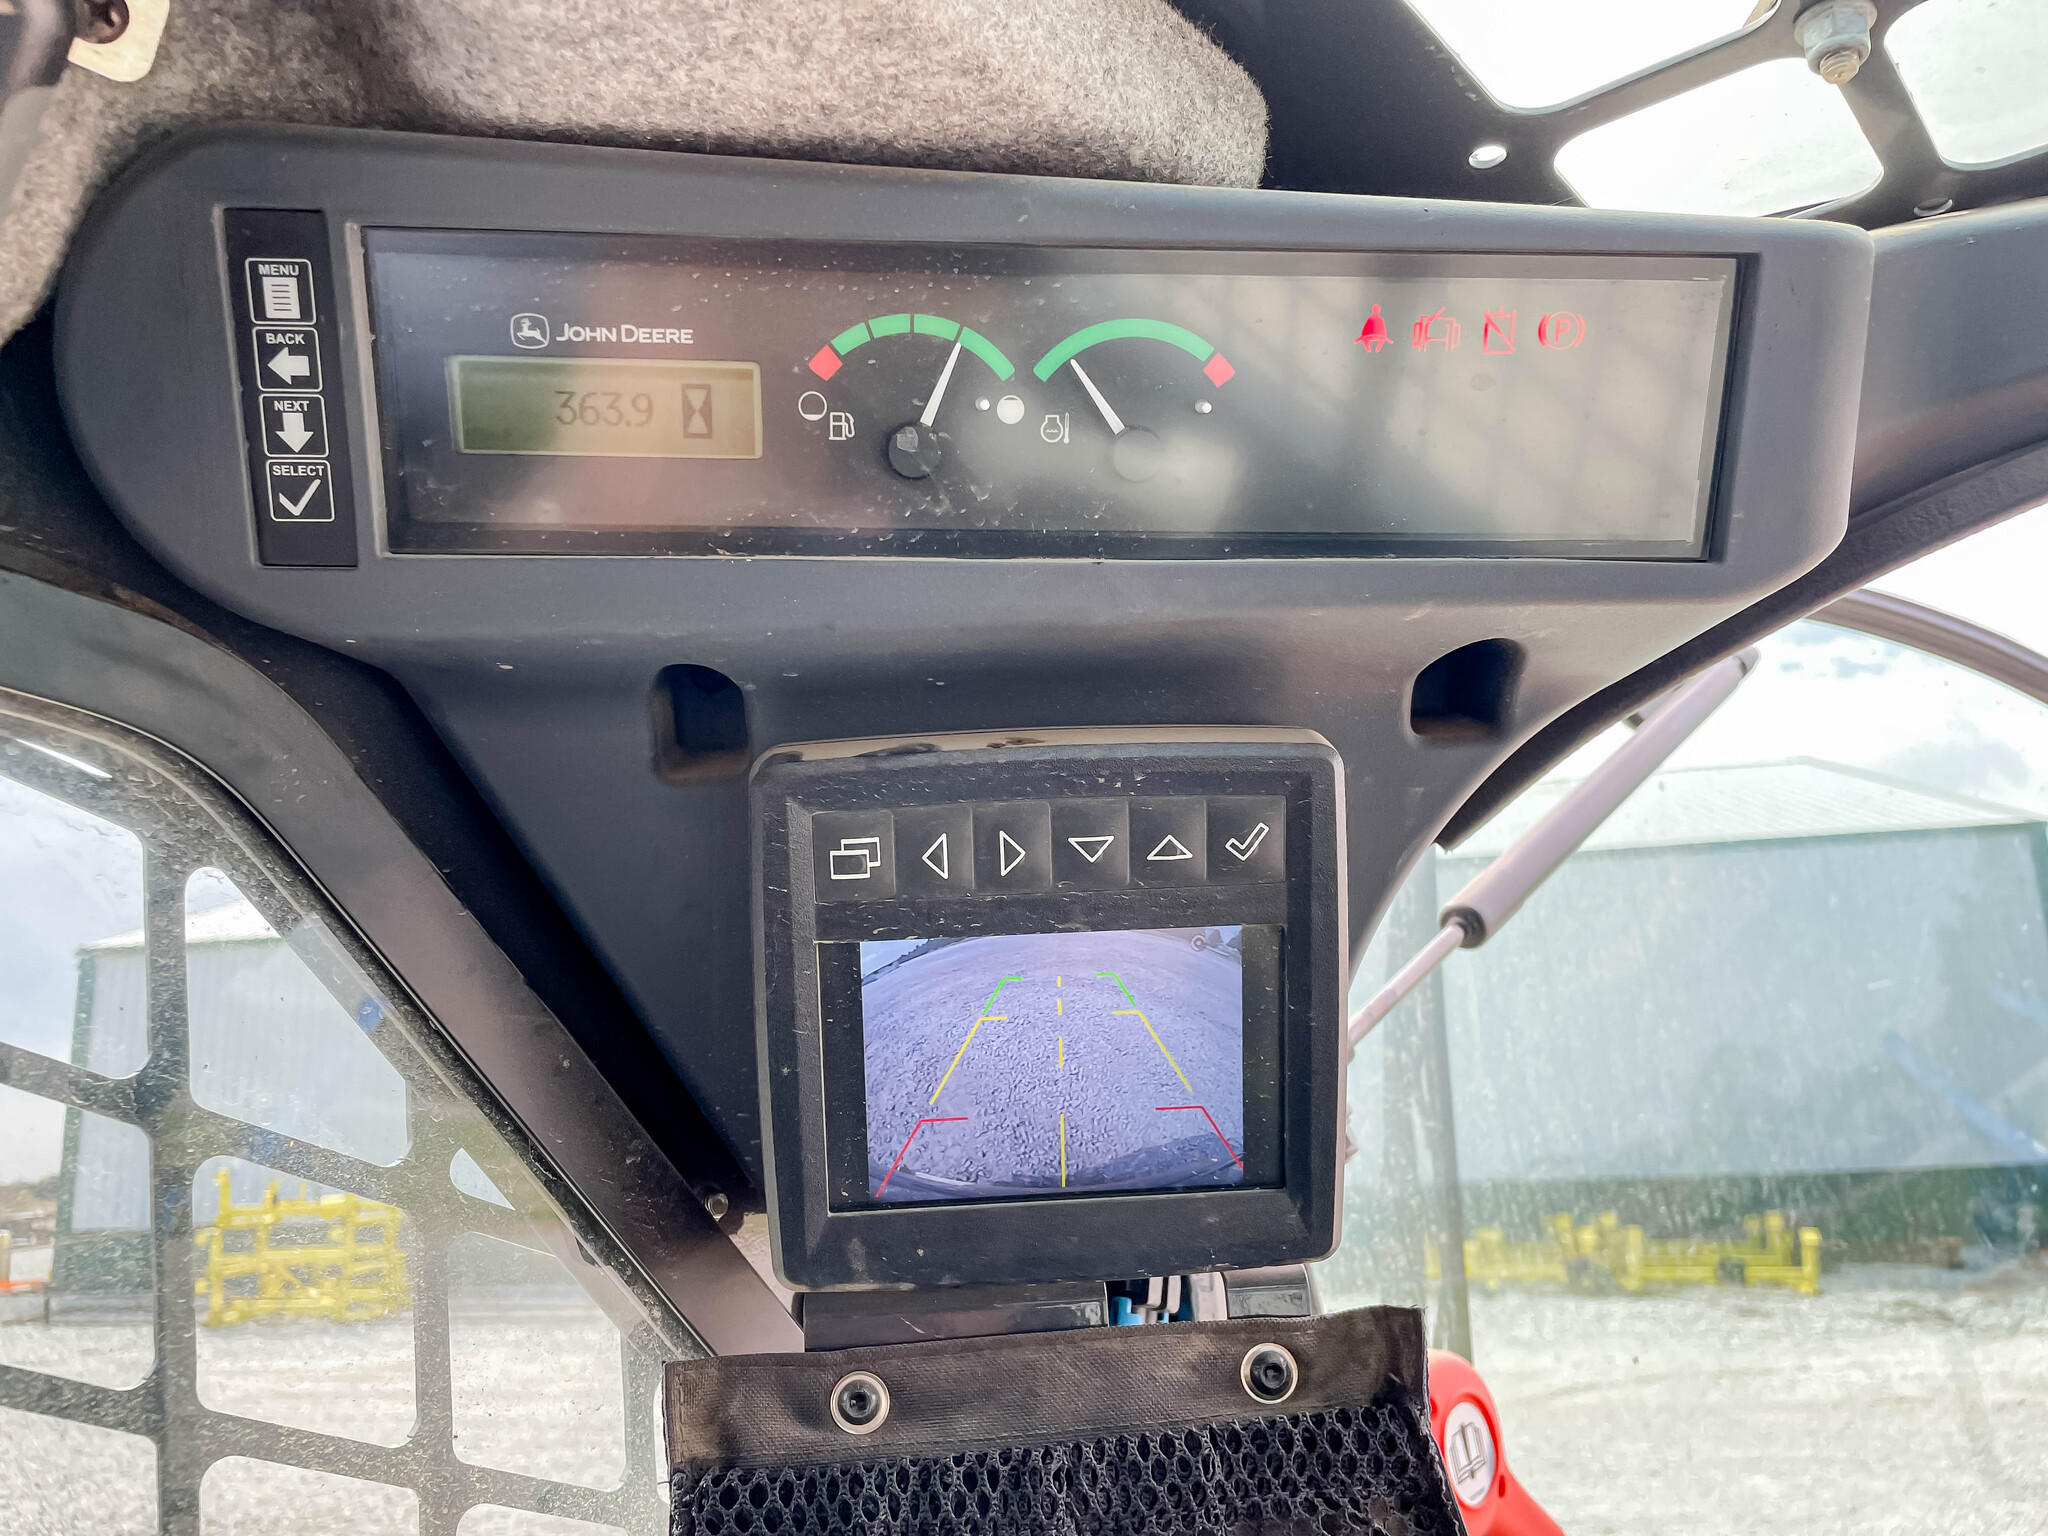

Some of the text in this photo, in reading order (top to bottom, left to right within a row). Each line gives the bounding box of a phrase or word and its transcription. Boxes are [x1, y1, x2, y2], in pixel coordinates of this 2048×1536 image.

[258, 264, 299, 276] MENU
[265, 332, 305, 345] BACK
[555, 323, 694, 344] JOHN DEERE
[274, 400, 309, 412] NEXT
[554, 390, 654, 427] 363.9
[272, 465, 324, 477] SELECT
